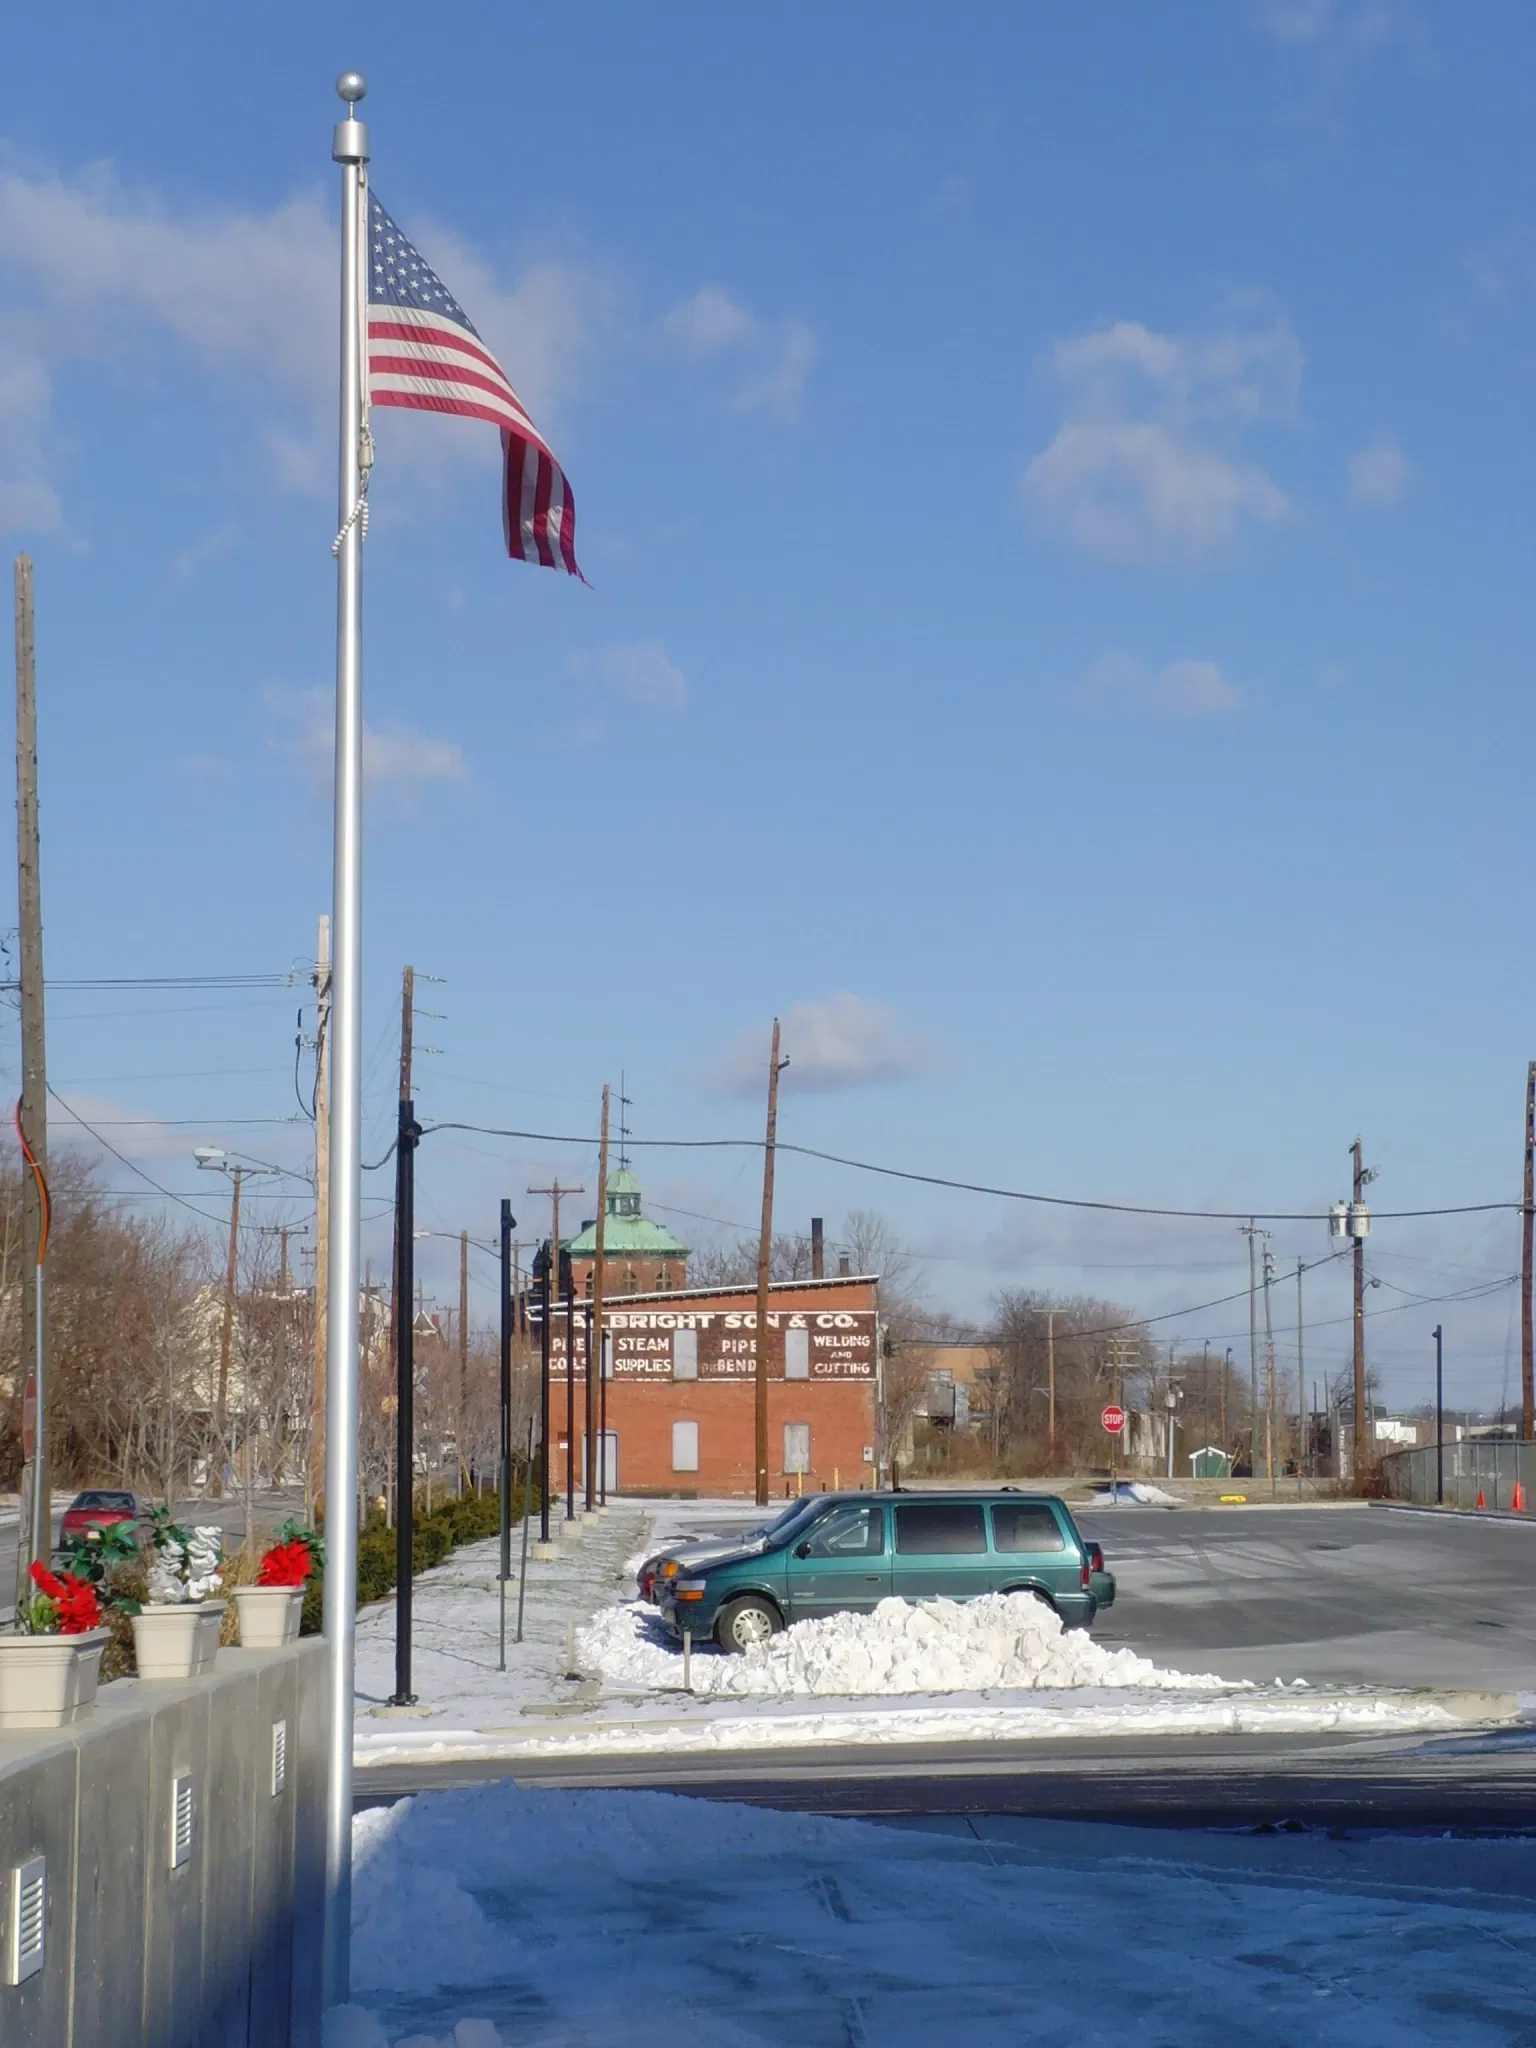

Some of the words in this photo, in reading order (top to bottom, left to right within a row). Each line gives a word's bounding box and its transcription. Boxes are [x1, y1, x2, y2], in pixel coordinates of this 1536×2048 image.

[789, 1314, 807, 1328] &
[816, 1313, 859, 1329] CO.
[552, 1337, 585, 1352] PIE
[618, 1337, 669, 1351] STEAM
[721, 1339, 757, 1353] PIPE
[813, 1335, 871, 1348] WELDING
[830, 1350, 853, 1359] AND
[549, 1357, 587, 1371] COLS
[615, 1359, 671, 1372] SUPPLIES
[717, 1358, 769, 1373] BEND
[814, 1362, 870, 1375] CUTTING
[1104, 1413, 1123, 1425] STOP
